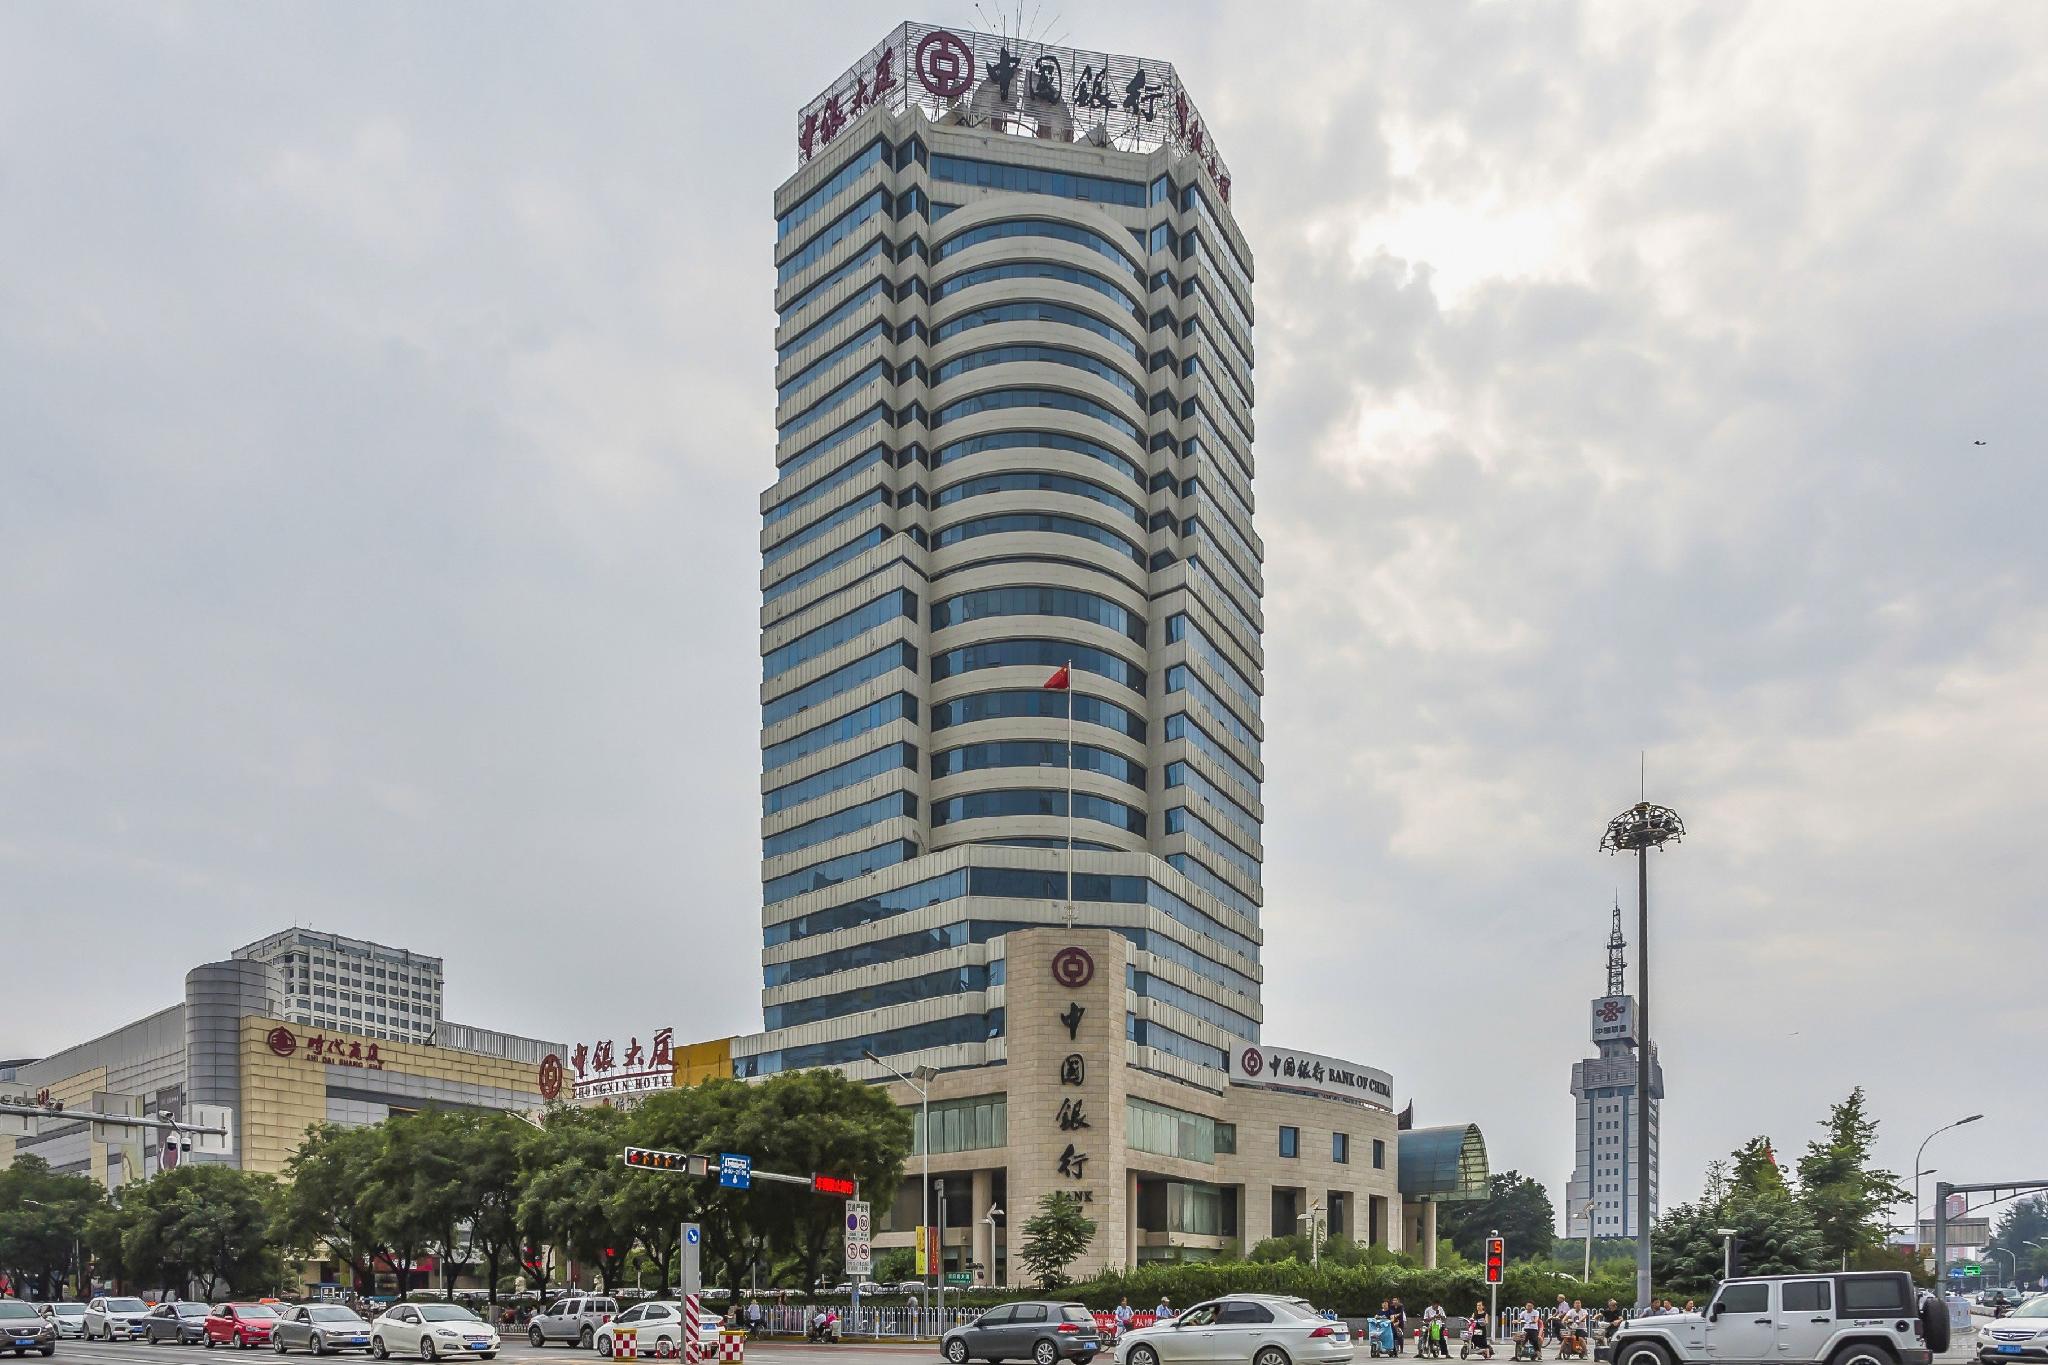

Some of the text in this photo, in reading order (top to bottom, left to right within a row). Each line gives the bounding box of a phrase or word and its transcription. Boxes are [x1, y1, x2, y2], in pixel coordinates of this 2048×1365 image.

[986, 46, 1165, 122] 中国银行
[571, 1027, 676, 1079] 中银大厦
[1269, 1054, 1391, 1099] 中国银行 BANK OF CHINA
[1056, 1002, 1091, 1180] 中国银行
